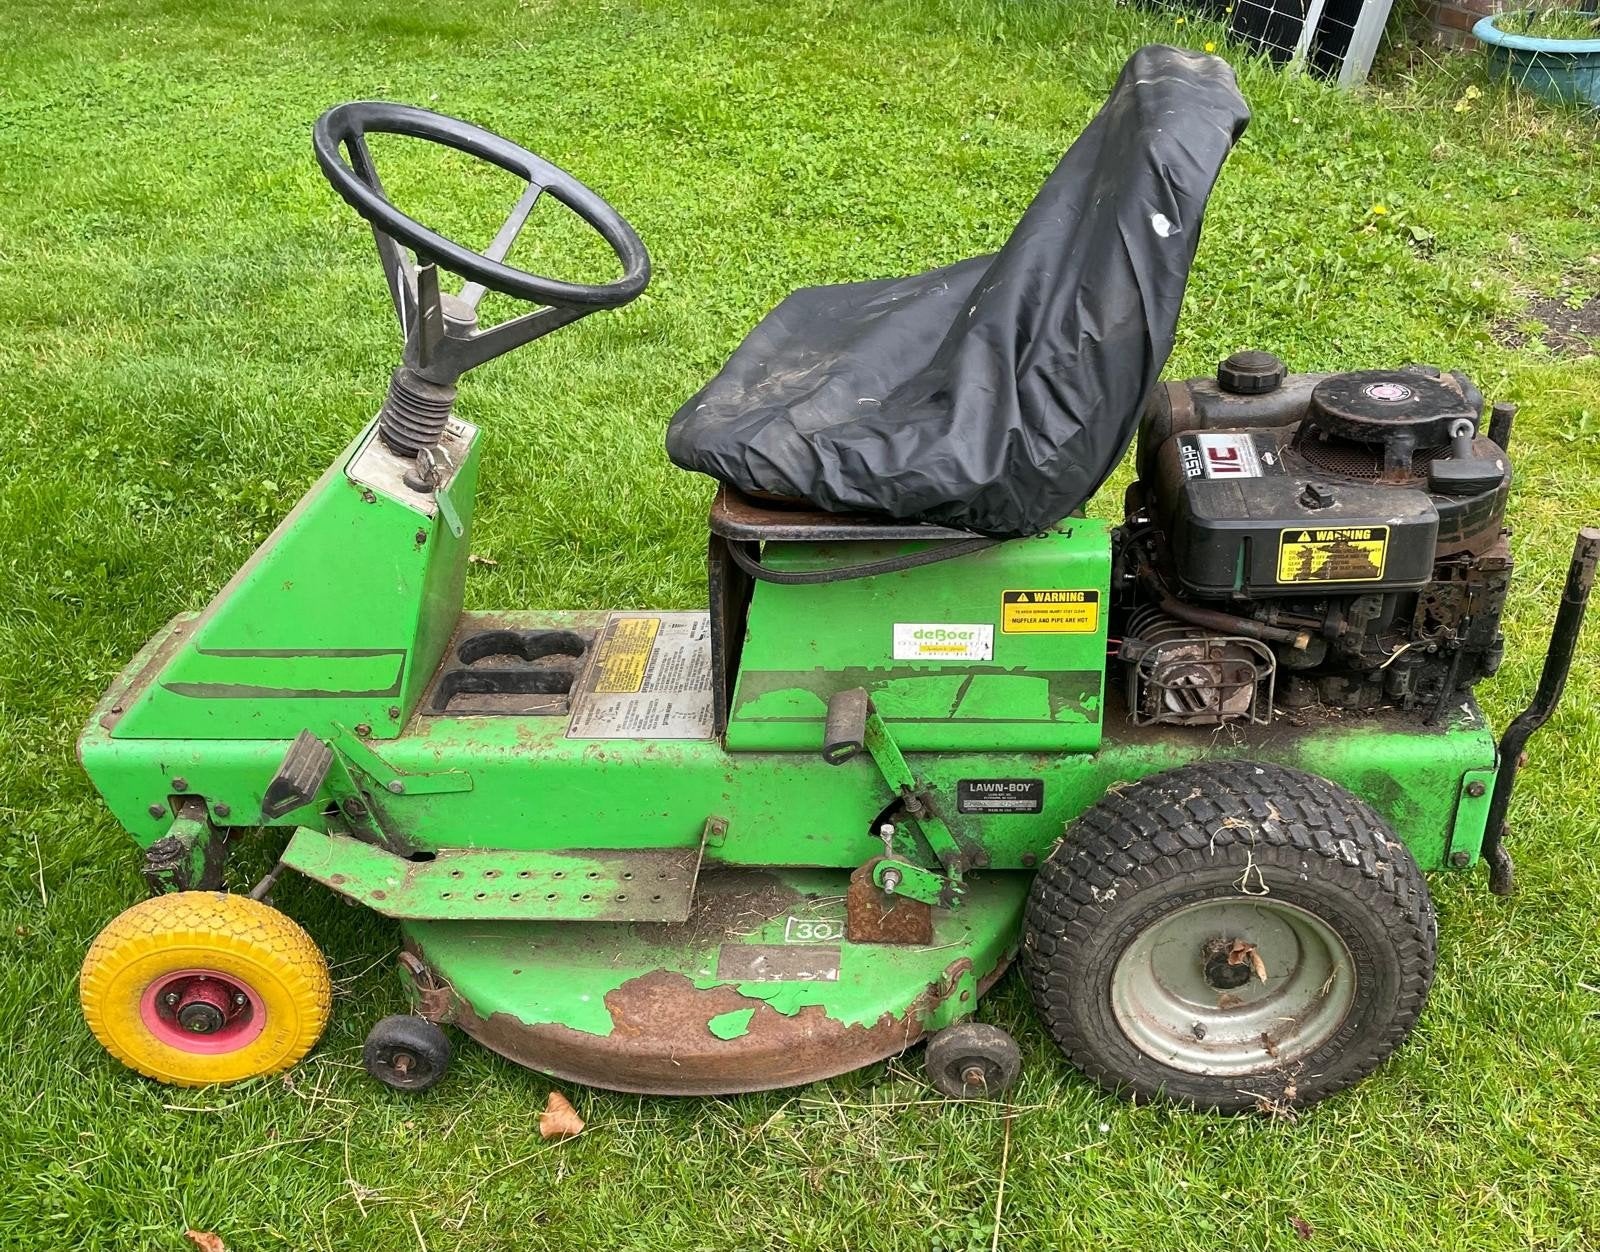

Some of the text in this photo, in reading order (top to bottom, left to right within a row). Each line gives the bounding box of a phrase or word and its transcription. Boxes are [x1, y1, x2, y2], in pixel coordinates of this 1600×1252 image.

[1033, 592, 1085, 602] WARNING
[913, 629, 975, 641] deBoer
[969, 783, 1031, 792] LAWN-BOY
[796, 923, 832, 939] 30
